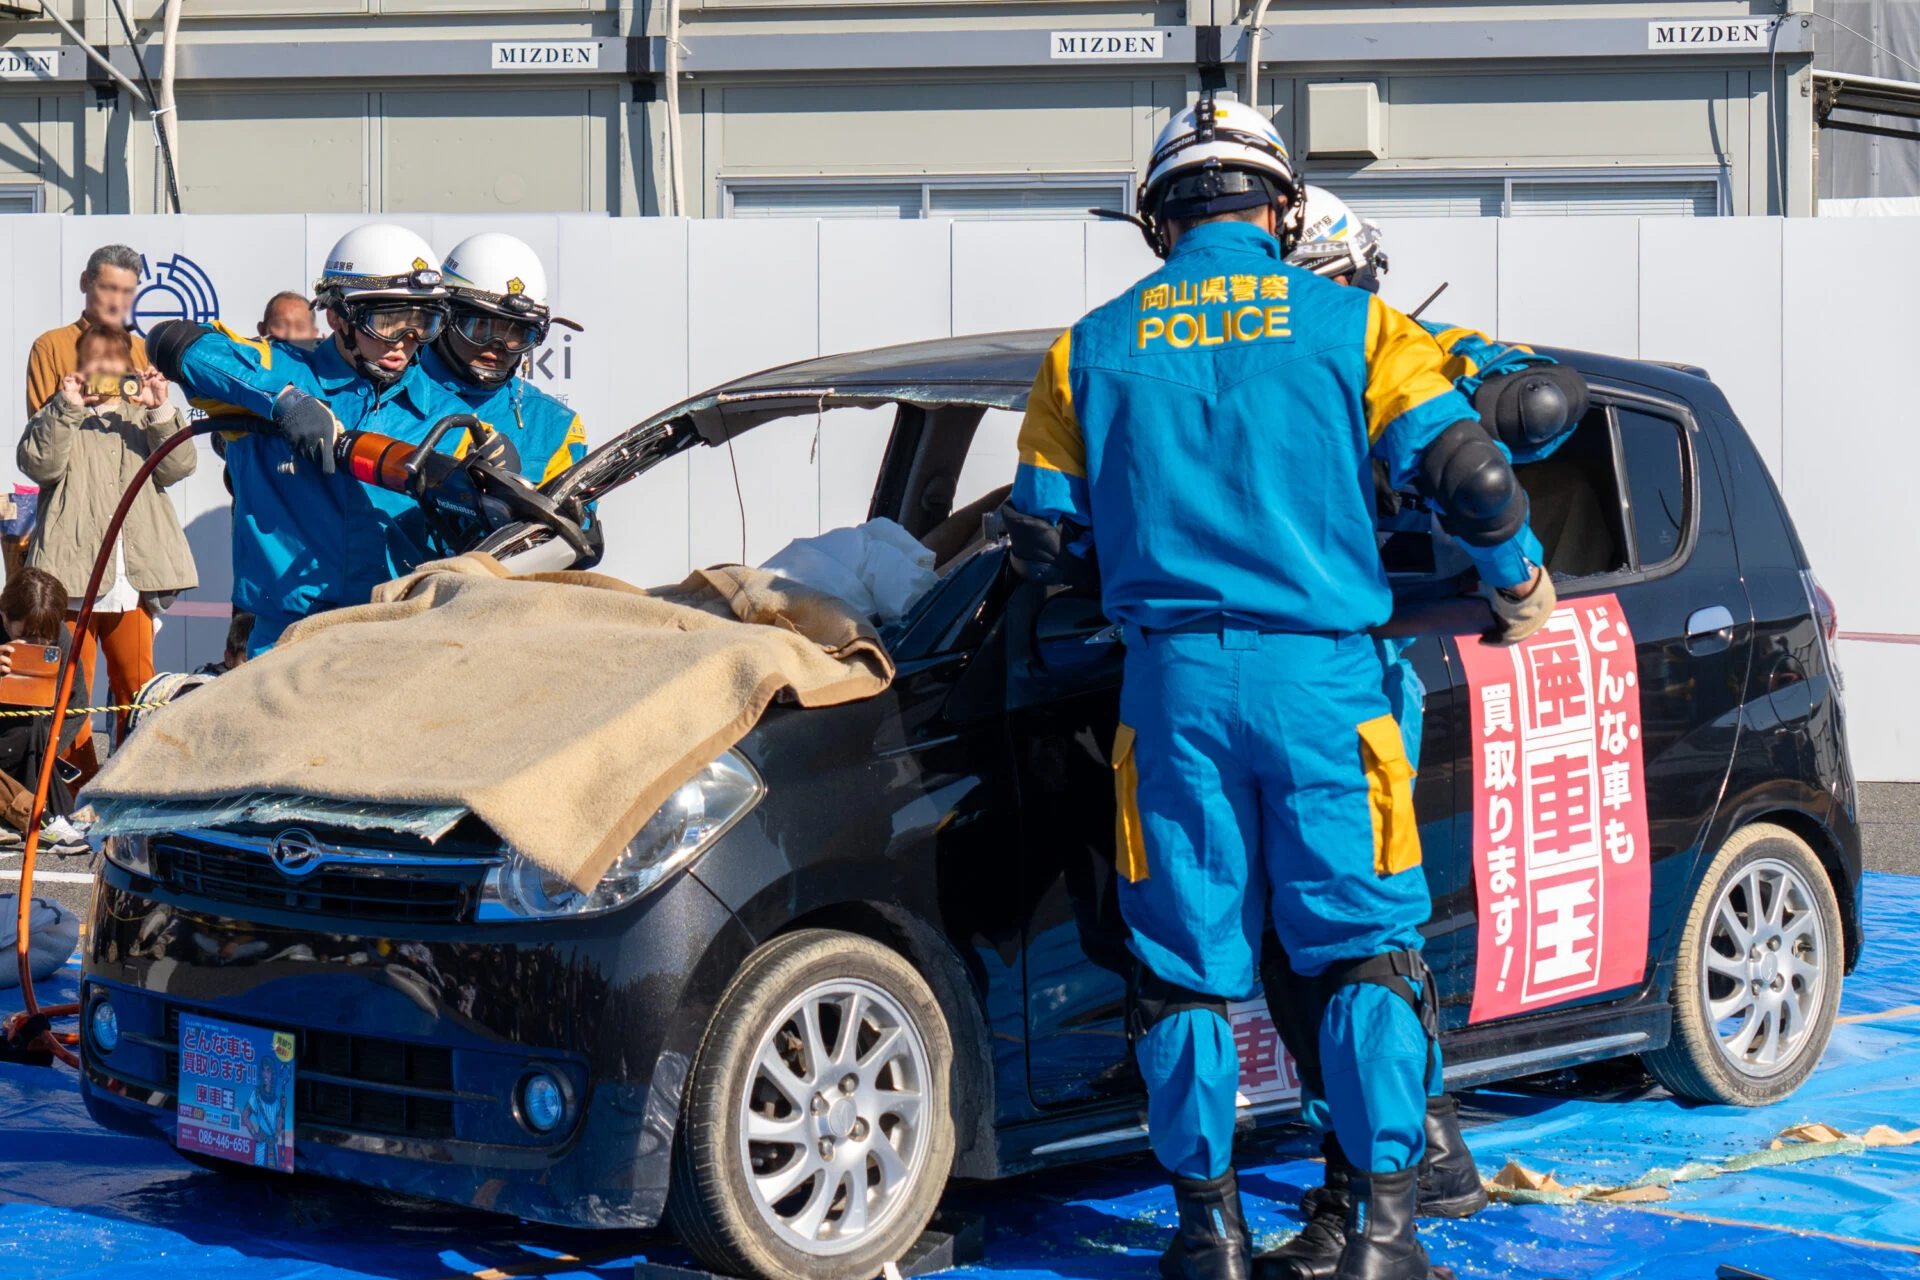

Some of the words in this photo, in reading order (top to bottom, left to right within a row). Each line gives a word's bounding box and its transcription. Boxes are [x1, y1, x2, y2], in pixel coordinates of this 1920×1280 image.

[1058, 37, 1155, 53] MIZDEN
[1656, 25, 1759, 43] MIZDEN
[499, 48, 591, 63] MIZDEN
[1140, 274, 1289, 312] 岡山県警察
[1137, 305, 1292, 349] POLICE
[1586, 605, 1638, 865] どんな車も
[198, 1129, 250, 1154] 086-446-6515
